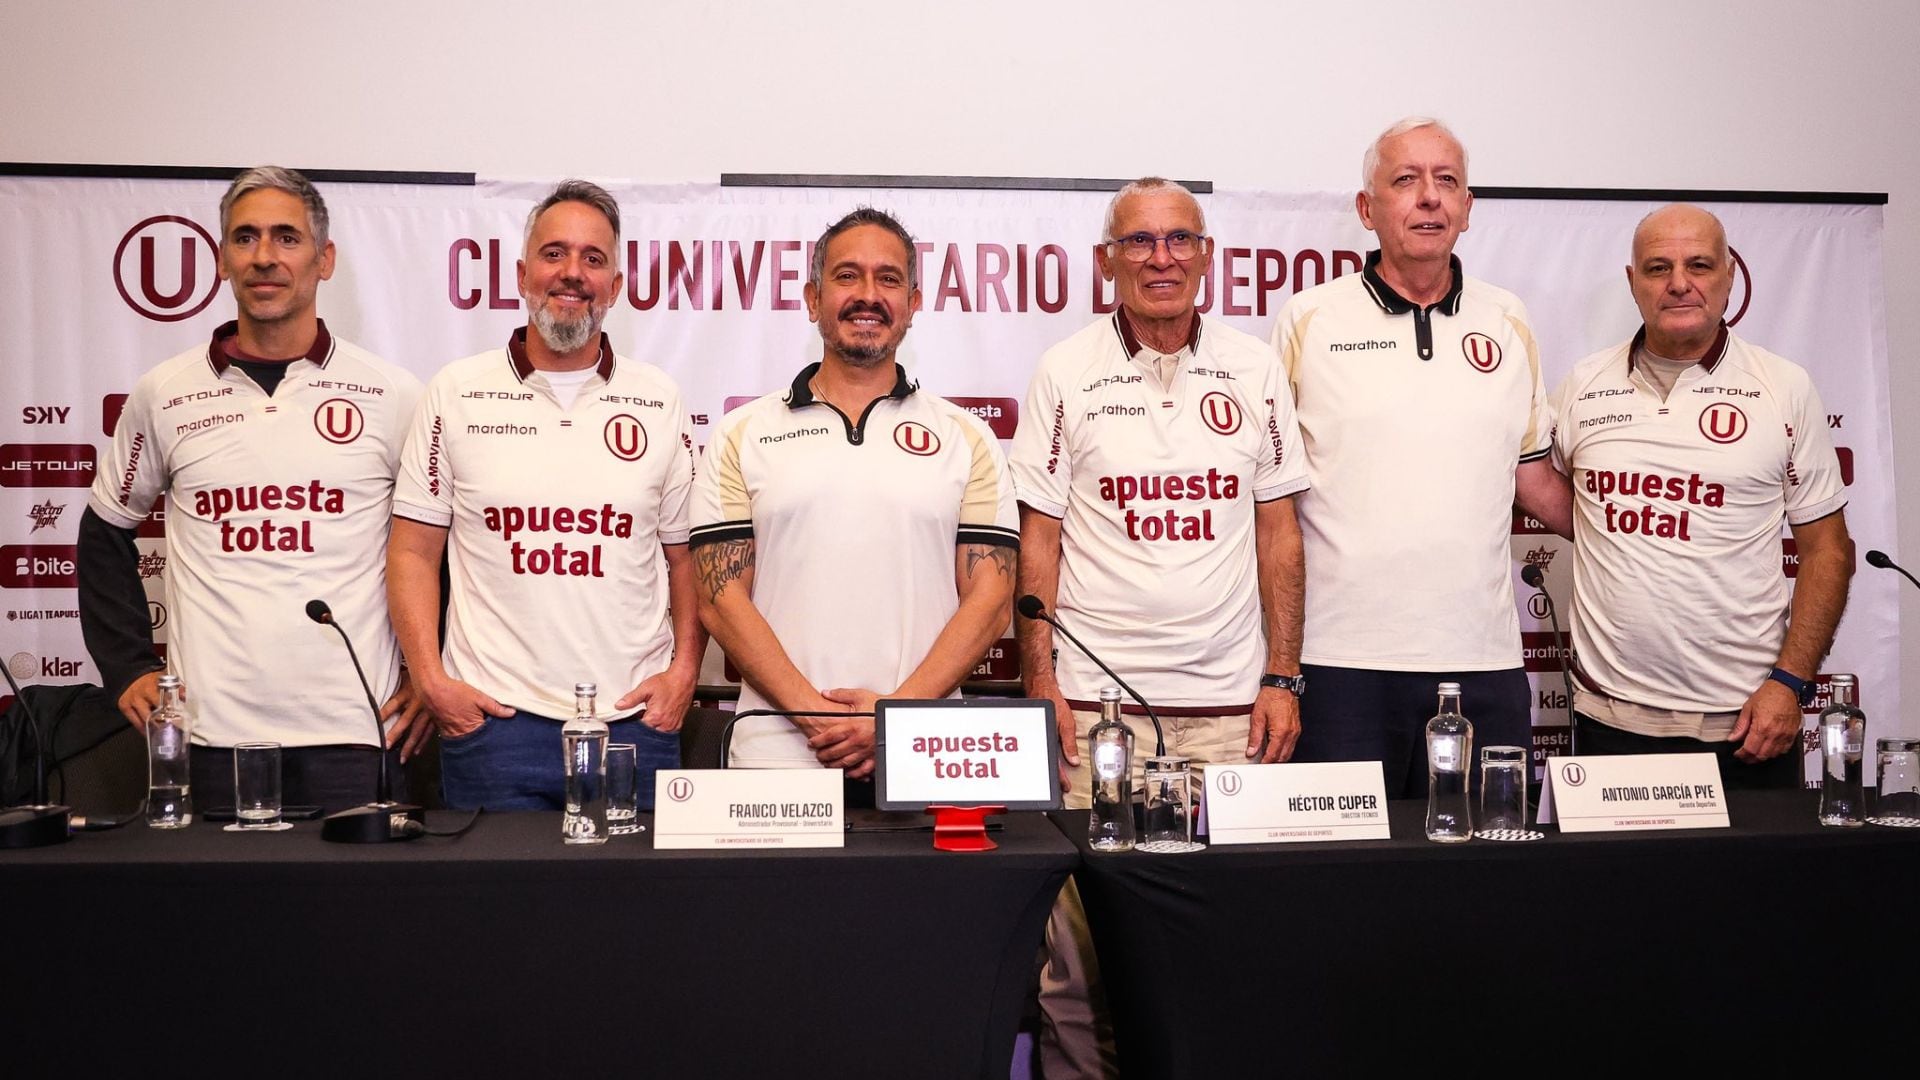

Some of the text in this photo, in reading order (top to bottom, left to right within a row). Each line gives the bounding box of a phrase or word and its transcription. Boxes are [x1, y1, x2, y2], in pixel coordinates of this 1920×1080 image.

[449, 238, 520, 310] CL
[627, 240, 1068, 314] UNIVETARIO
[1330, 339, 1397, 352] marathon
[162, 380, 384, 410] JETOUR JETOUR
[461, 391, 664, 409] JETOUR JETOUR
[1579, 386, 1761, 401] JETOUR JETOUR
[22, 406, 71, 425] SKY
[1087, 404, 1145, 421] mrathon
[1580, 413, 1632, 429] marathon
[176, 413, 244, 435] marathon
[467, 420, 537, 435] marathon
[759, 427, 829, 445] marathon
[1269, 415, 1283, 466] OVISUN
[429, 416, 441, 477] MOVISUN
[2, 460, 93, 471] JETOUR
[121, 432, 145, 494] MOVISUN
[1098, 468, 1239, 509] apuesta
[1586, 470, 1725, 507] apuesta
[31, 504, 63, 515] Electro
[194, 480, 345, 522] apuesta
[36, 516, 58, 528] light
[483, 504, 633, 541] apuesta
[1124, 509, 1215, 541] total
[1605, 503, 1691, 541] total
[221, 519, 315, 552] total
[34, 557, 75, 575] bite
[510, 542, 604, 577] total
[45, 609, 80, 619] TEAPUES
[41, 657, 83, 677] klar
[1540, 691, 1567, 709] kla
[912, 732, 1018, 758] apuesta
[1532, 733, 1568, 745] uesta
[1534, 748, 1560, 760] otal
[934, 758, 1000, 779] total
[1602, 783, 1715, 802] ANTONIO GARCÍA PYE
[729, 803, 833, 818] FRANCO VELAZCO
[1288, 795, 1377, 812] HÉCTOR CUPER
